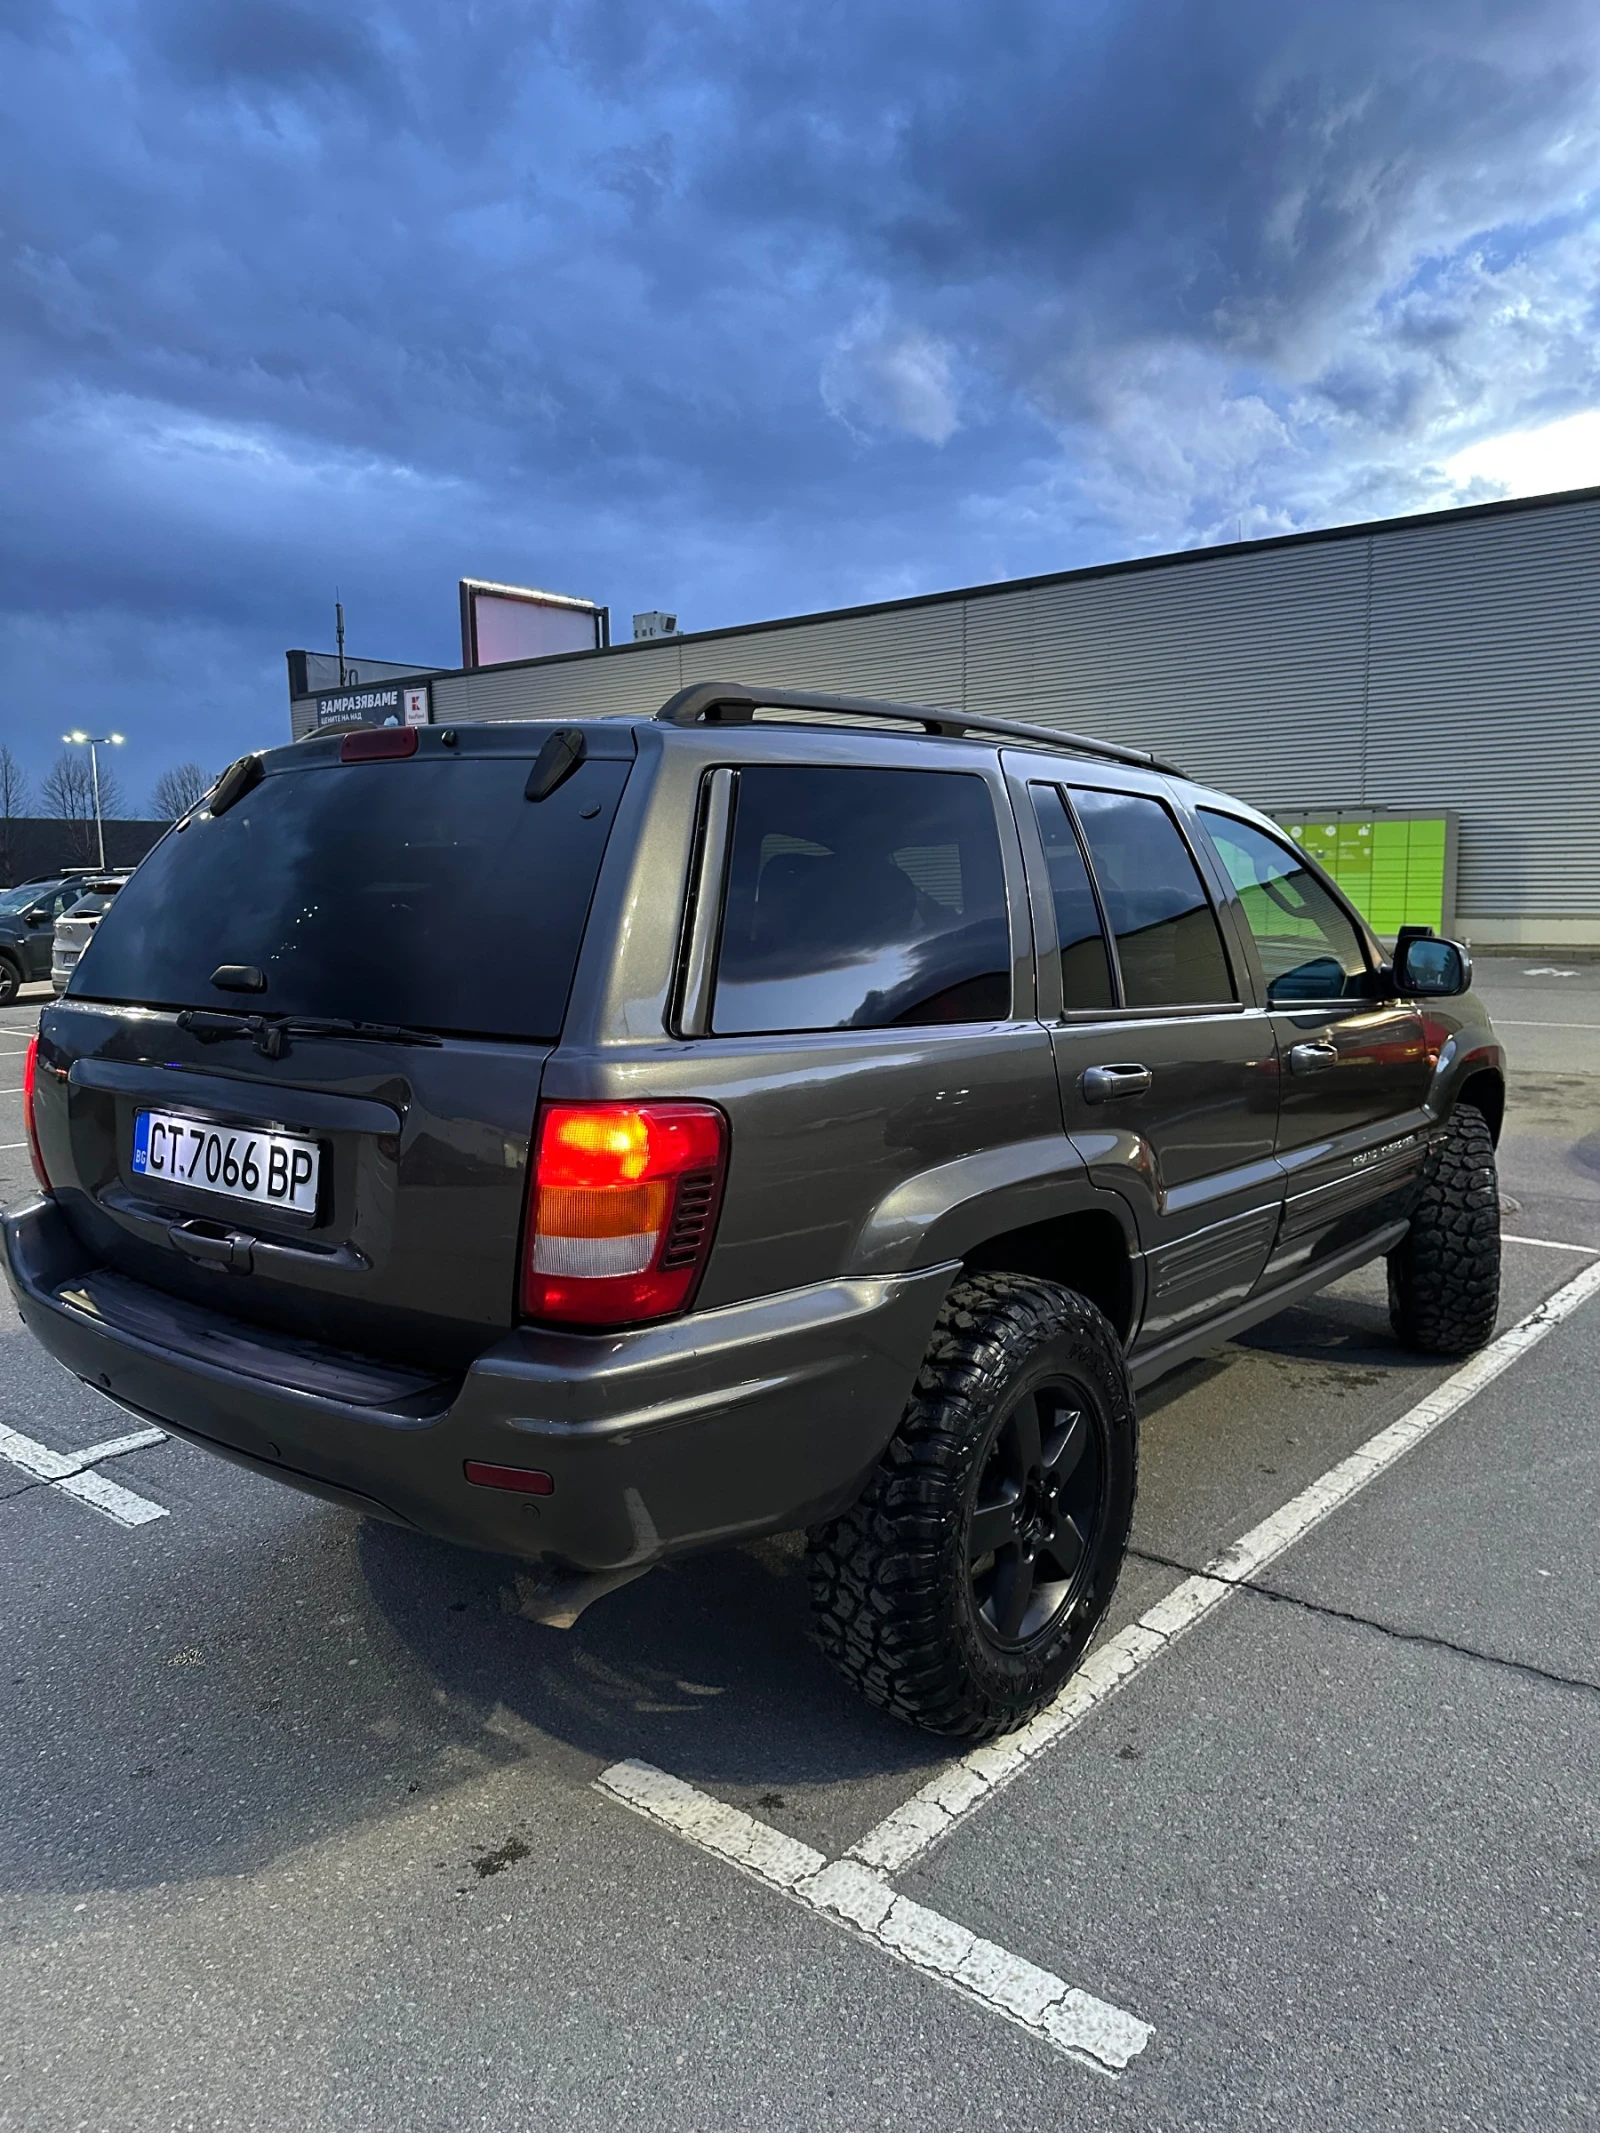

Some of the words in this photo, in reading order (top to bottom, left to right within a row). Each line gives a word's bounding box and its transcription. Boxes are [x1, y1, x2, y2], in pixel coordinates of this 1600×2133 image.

[320, 691, 398, 714] ЗАМРАЗЯВАМЕ
[341, 714, 350, 722] НА
[135, 1149, 146, 1164] BG
[267, 1144, 313, 1202] BP
